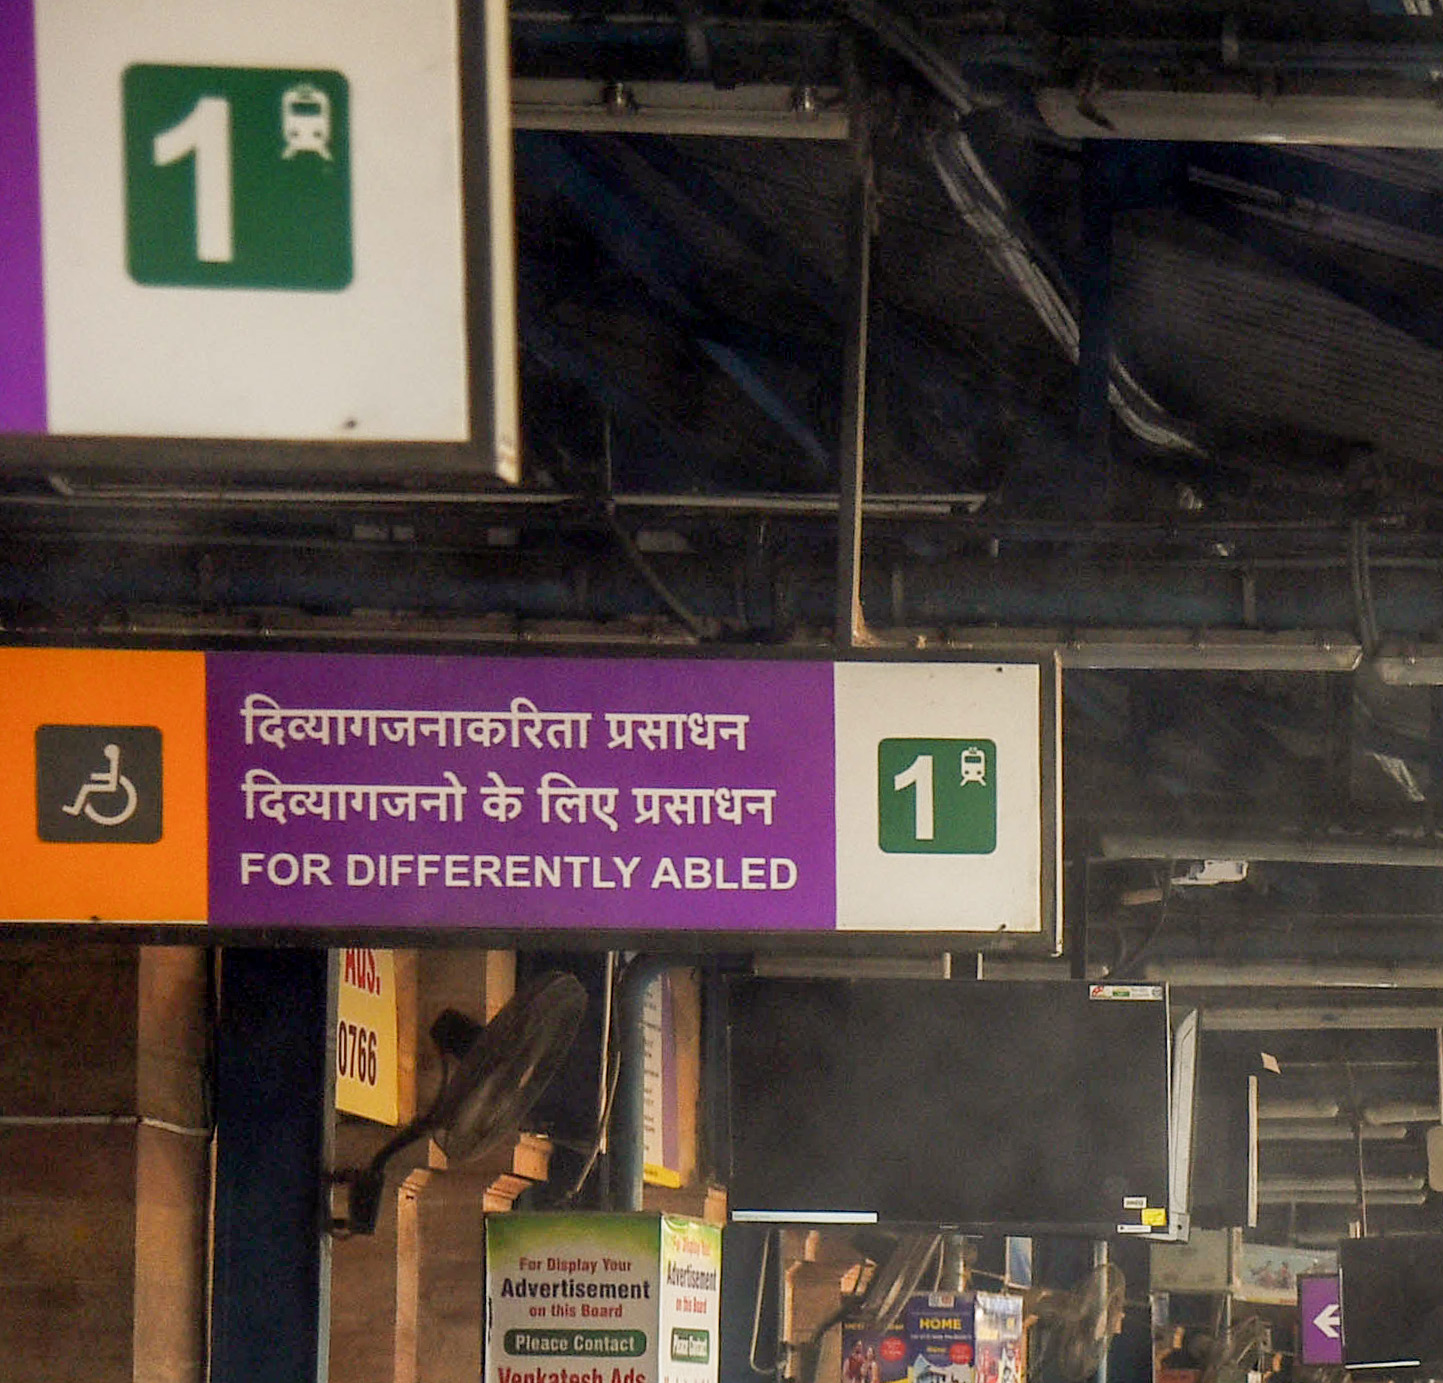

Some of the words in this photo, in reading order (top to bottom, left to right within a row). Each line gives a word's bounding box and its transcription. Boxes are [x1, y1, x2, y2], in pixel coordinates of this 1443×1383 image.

[153, 96, 233, 262] 1
[604, 712, 750, 751] प्रसाधन
[241, 769, 467, 824] दिव्यागजनो
[480, 771, 525, 823] के
[536, 772, 619, 831] लिए
[631, 787, 777, 826] प्रसाधन
[894, 754, 934, 840] 1
[240, 853, 333, 887] FOR
[346, 854, 640, 889] DIFFERENTLY
[651, 856, 798, 890] ABLED
[338, 1020, 377, 1086] 0766
[519, 1257, 541, 1271] For
[547, 1257, 597, 1275] Display
[602, 1258, 632, 1271] Your
[666, 1261, 717, 1292] Advertisement
[501, 1278, 650, 1300] Advertisement
[529, 1306, 546, 1317] on
[551, 1304, 576, 1317] this
[581, 1304, 623, 1317] Board
[919, 1317, 963, 1331] HOME
[573, 1334, 635, 1351] Contact
